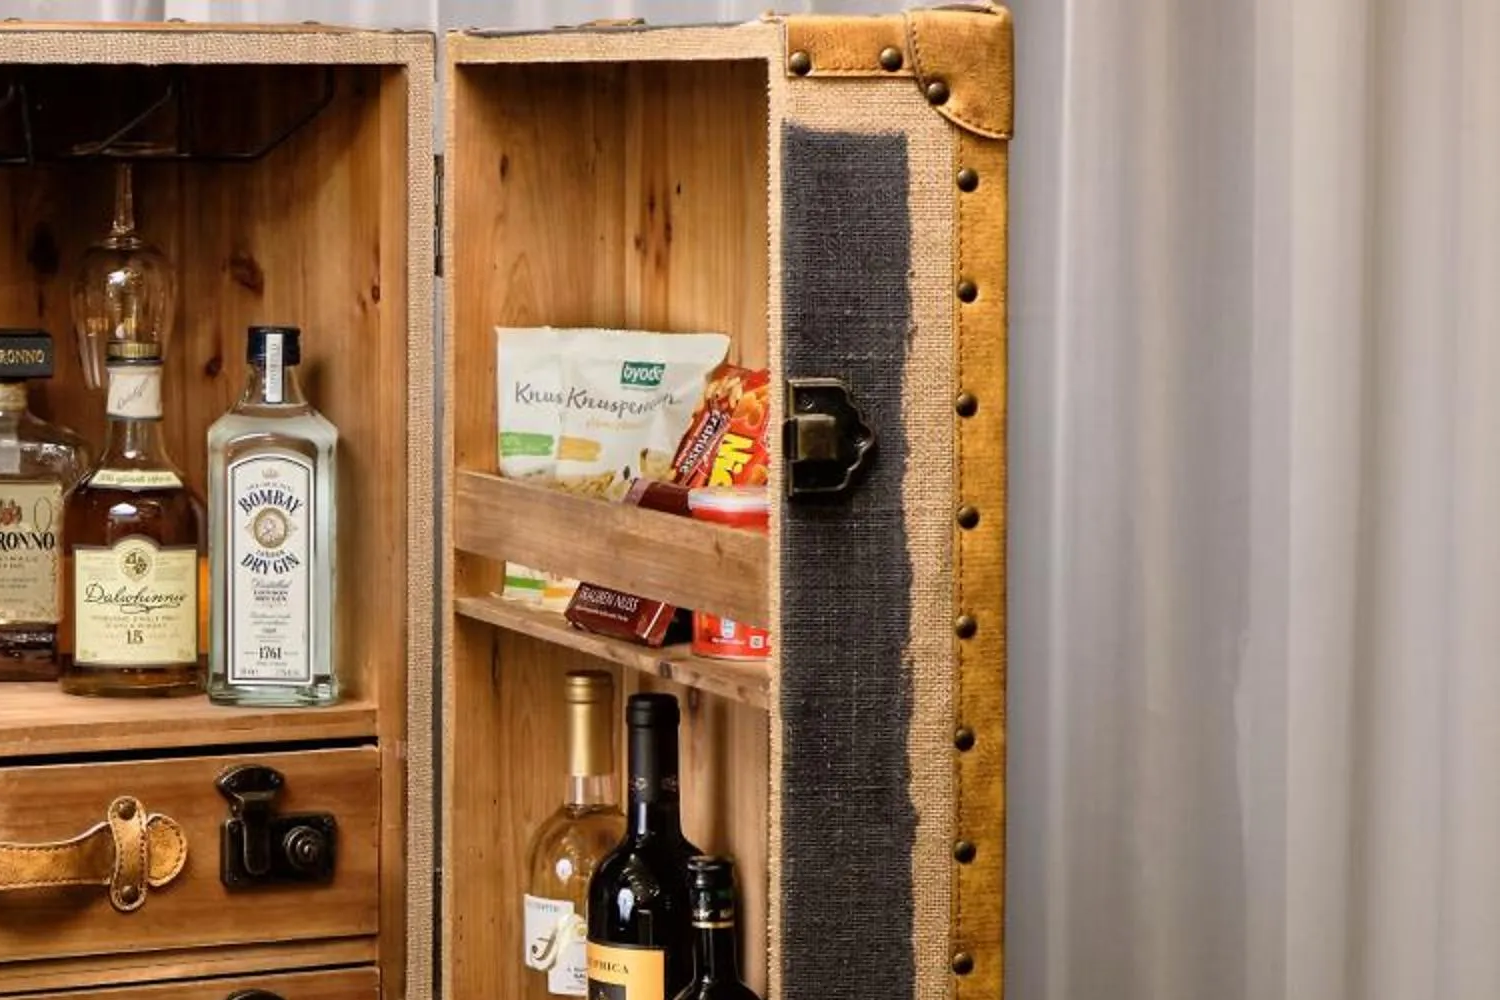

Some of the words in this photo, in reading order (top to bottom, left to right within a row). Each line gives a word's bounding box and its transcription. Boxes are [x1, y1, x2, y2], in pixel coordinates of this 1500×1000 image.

[238, 489, 303, 515] BOMBAY
[241, 553, 268, 575] DRY
[273, 553, 301, 574] GIN
[127, 629, 143, 644] 15
